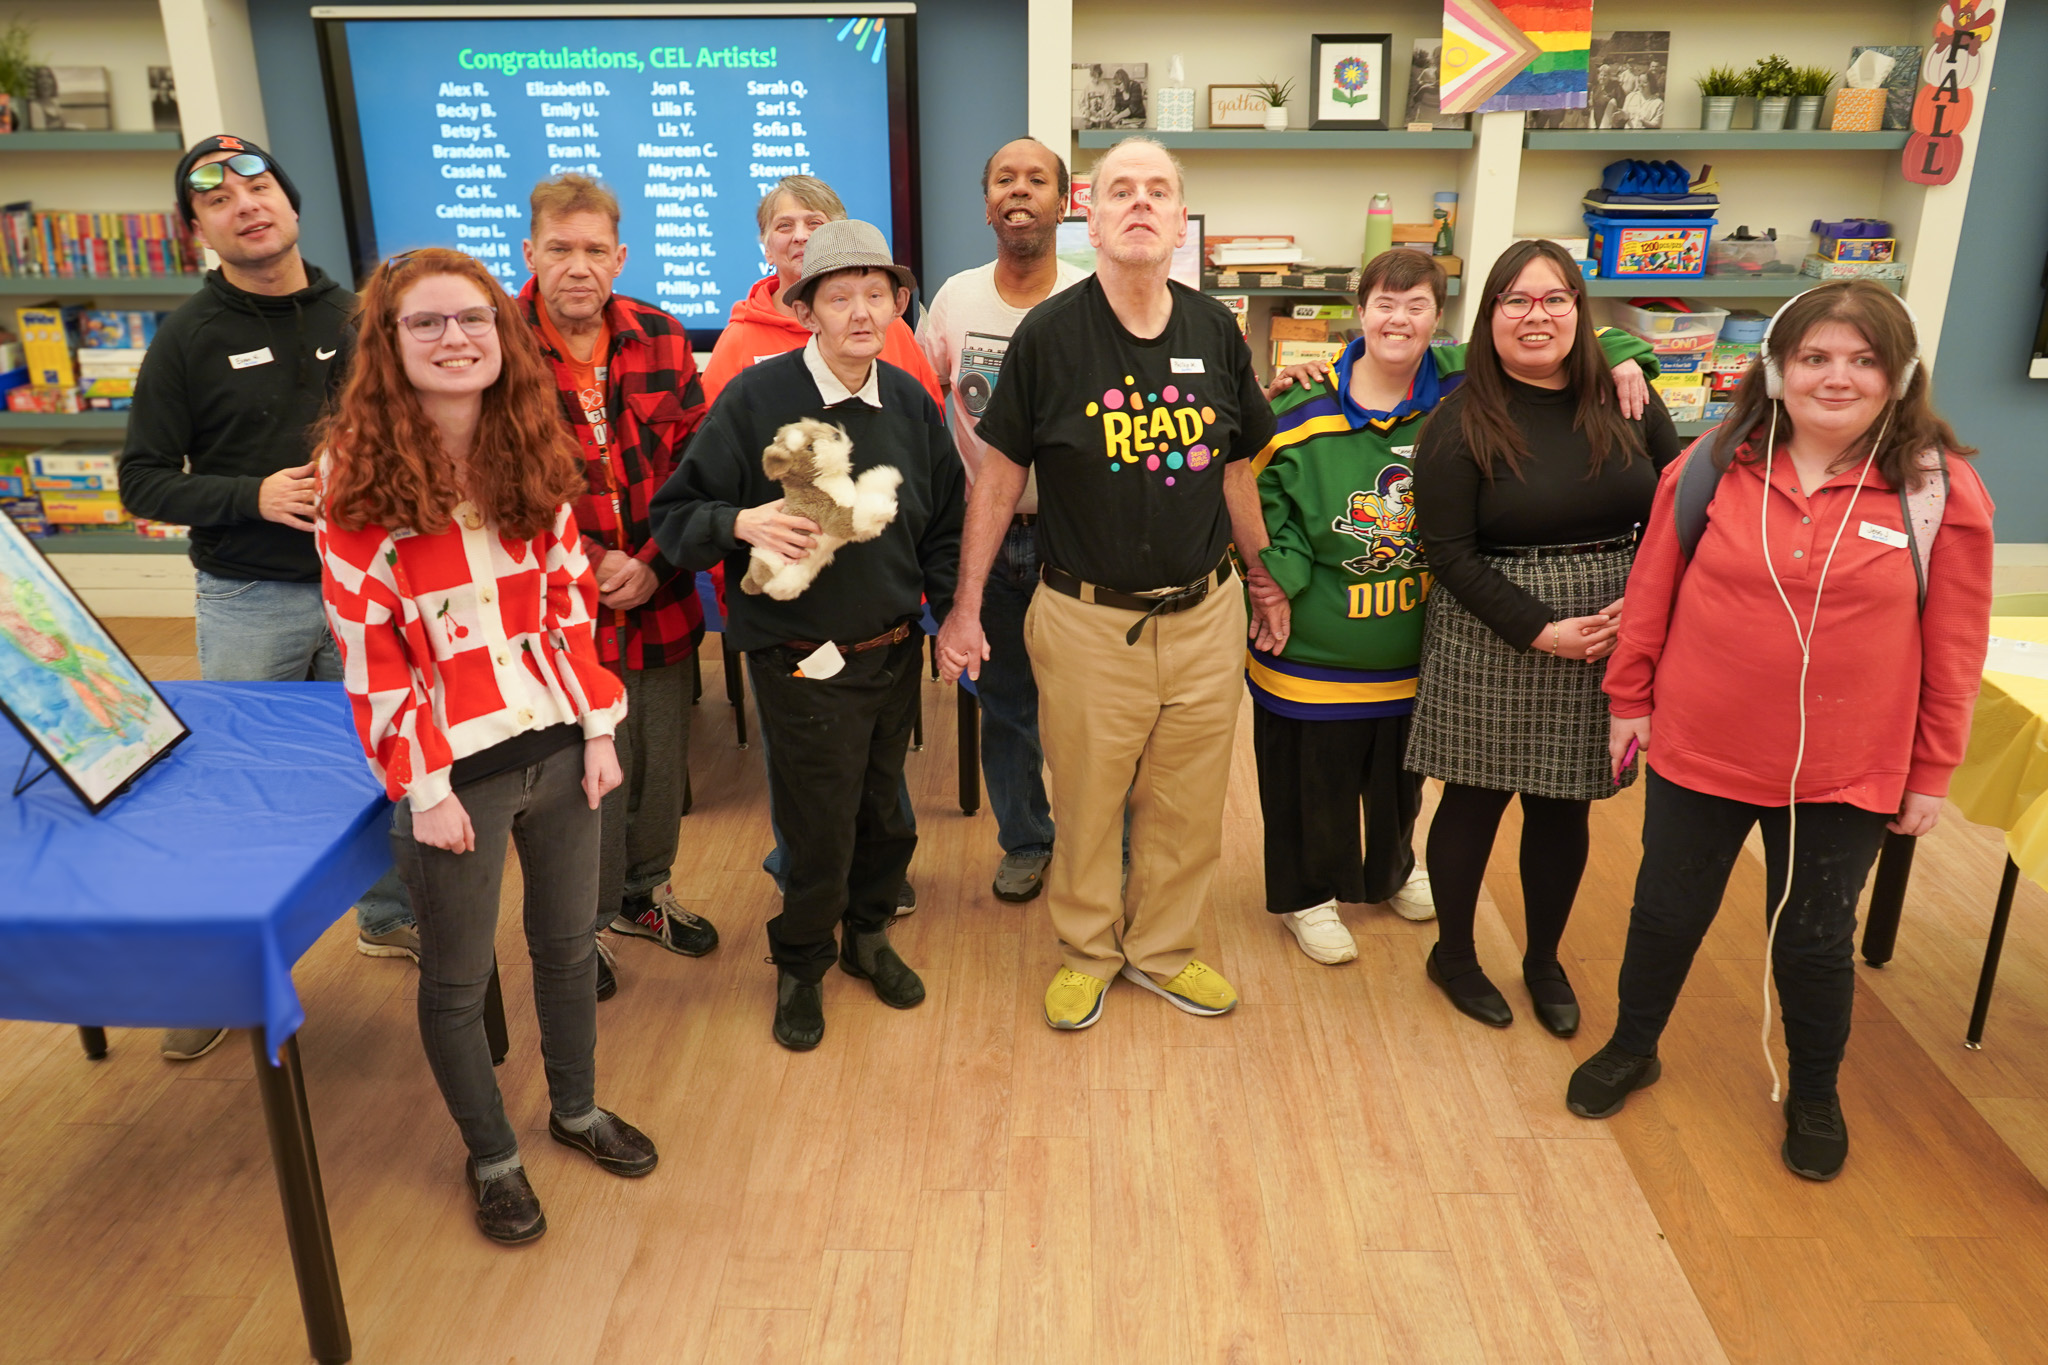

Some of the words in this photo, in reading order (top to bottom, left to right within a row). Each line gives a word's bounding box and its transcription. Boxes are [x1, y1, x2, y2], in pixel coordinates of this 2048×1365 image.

[458, 46, 645, 76] Congratulations,
[648, 46, 693, 69] CEL
[695, 44, 778, 69] Artists!
[439, 82, 472, 97] Alex
[473, 82, 489, 97] R.
[526, 81, 592, 97] Elizabeth
[593, 81, 611, 97] D.
[650, 81, 678, 96] Jon
[678, 80, 695, 96] R.
[747, 79, 789, 96] Sarah
[790, 80, 808, 99] Q.
[540, 101, 581, 121] Emily
[582, 102, 600, 117] U.
[683, 101, 697, 117] F.
[756, 100, 785, 117] Sari
[786, 101, 802, 116] S.
[1217, 93, 1267, 121] gather
[1920, 30, 1976, 176] FALL
[436, 102, 479, 121] Becky
[480, 103, 497, 118] B.
[440, 124, 481, 141] Betsy
[482, 123, 497, 139] S.
[545, 123, 581, 138] Evan
[581, 123, 599, 138] N.
[657, 122, 679, 138] Liz
[679, 122, 695, 137] Y.
[752, 120, 790, 137] Sofia
[791, 122, 807, 137] B.
[432, 143, 494, 159] Brandon
[494, 143, 511, 158] R.
[547, 143, 583, 158] Evan
[583, 143, 601, 158] N.
[637, 143, 702, 158] Maureen
[702, 142, 718, 158] C.
[751, 142, 793, 158] Steve
[794, 142, 810, 157] B.
[441, 164, 486, 179] Cassie
[487, 164, 507, 178] M.
[586, 163, 603, 178] B.
[647, 163, 694, 181] Mayra
[694, 163, 711, 178] A.
[749, 162, 800, 179] Steven
[455, 184, 481, 199] Cat
[481, 184, 497, 198] K.
[644, 182, 700, 201] Mikayla
[700, 183, 718, 198] N.
[436, 203, 504, 219] Catherine
[504, 204, 522, 218] N.
[656, 202, 692, 218] Mike
[692, 202, 710, 218] G.
[456, 223, 491, 238] Dara
[491, 224, 506, 238] L.
[655, 222, 697, 238] Mitch
[697, 223, 713, 237] K.
[454, 243, 497, 258] David
[654, 241, 700, 257] Nicole
[700, 242, 717, 257] K.
[1641, 241, 1660, 253] 1200
[501, 262, 516, 277] S.
[663, 261, 695, 277] Paul
[695, 261, 711, 276] C.
[656, 280, 701, 299] Phillip
[701, 281, 721, 295] M.
[704, 300, 720, 314] B.
[1671, 337, 1698, 349] UNO
[1684, 374, 1699, 382] 500
[1102, 406, 1204, 464] READ
